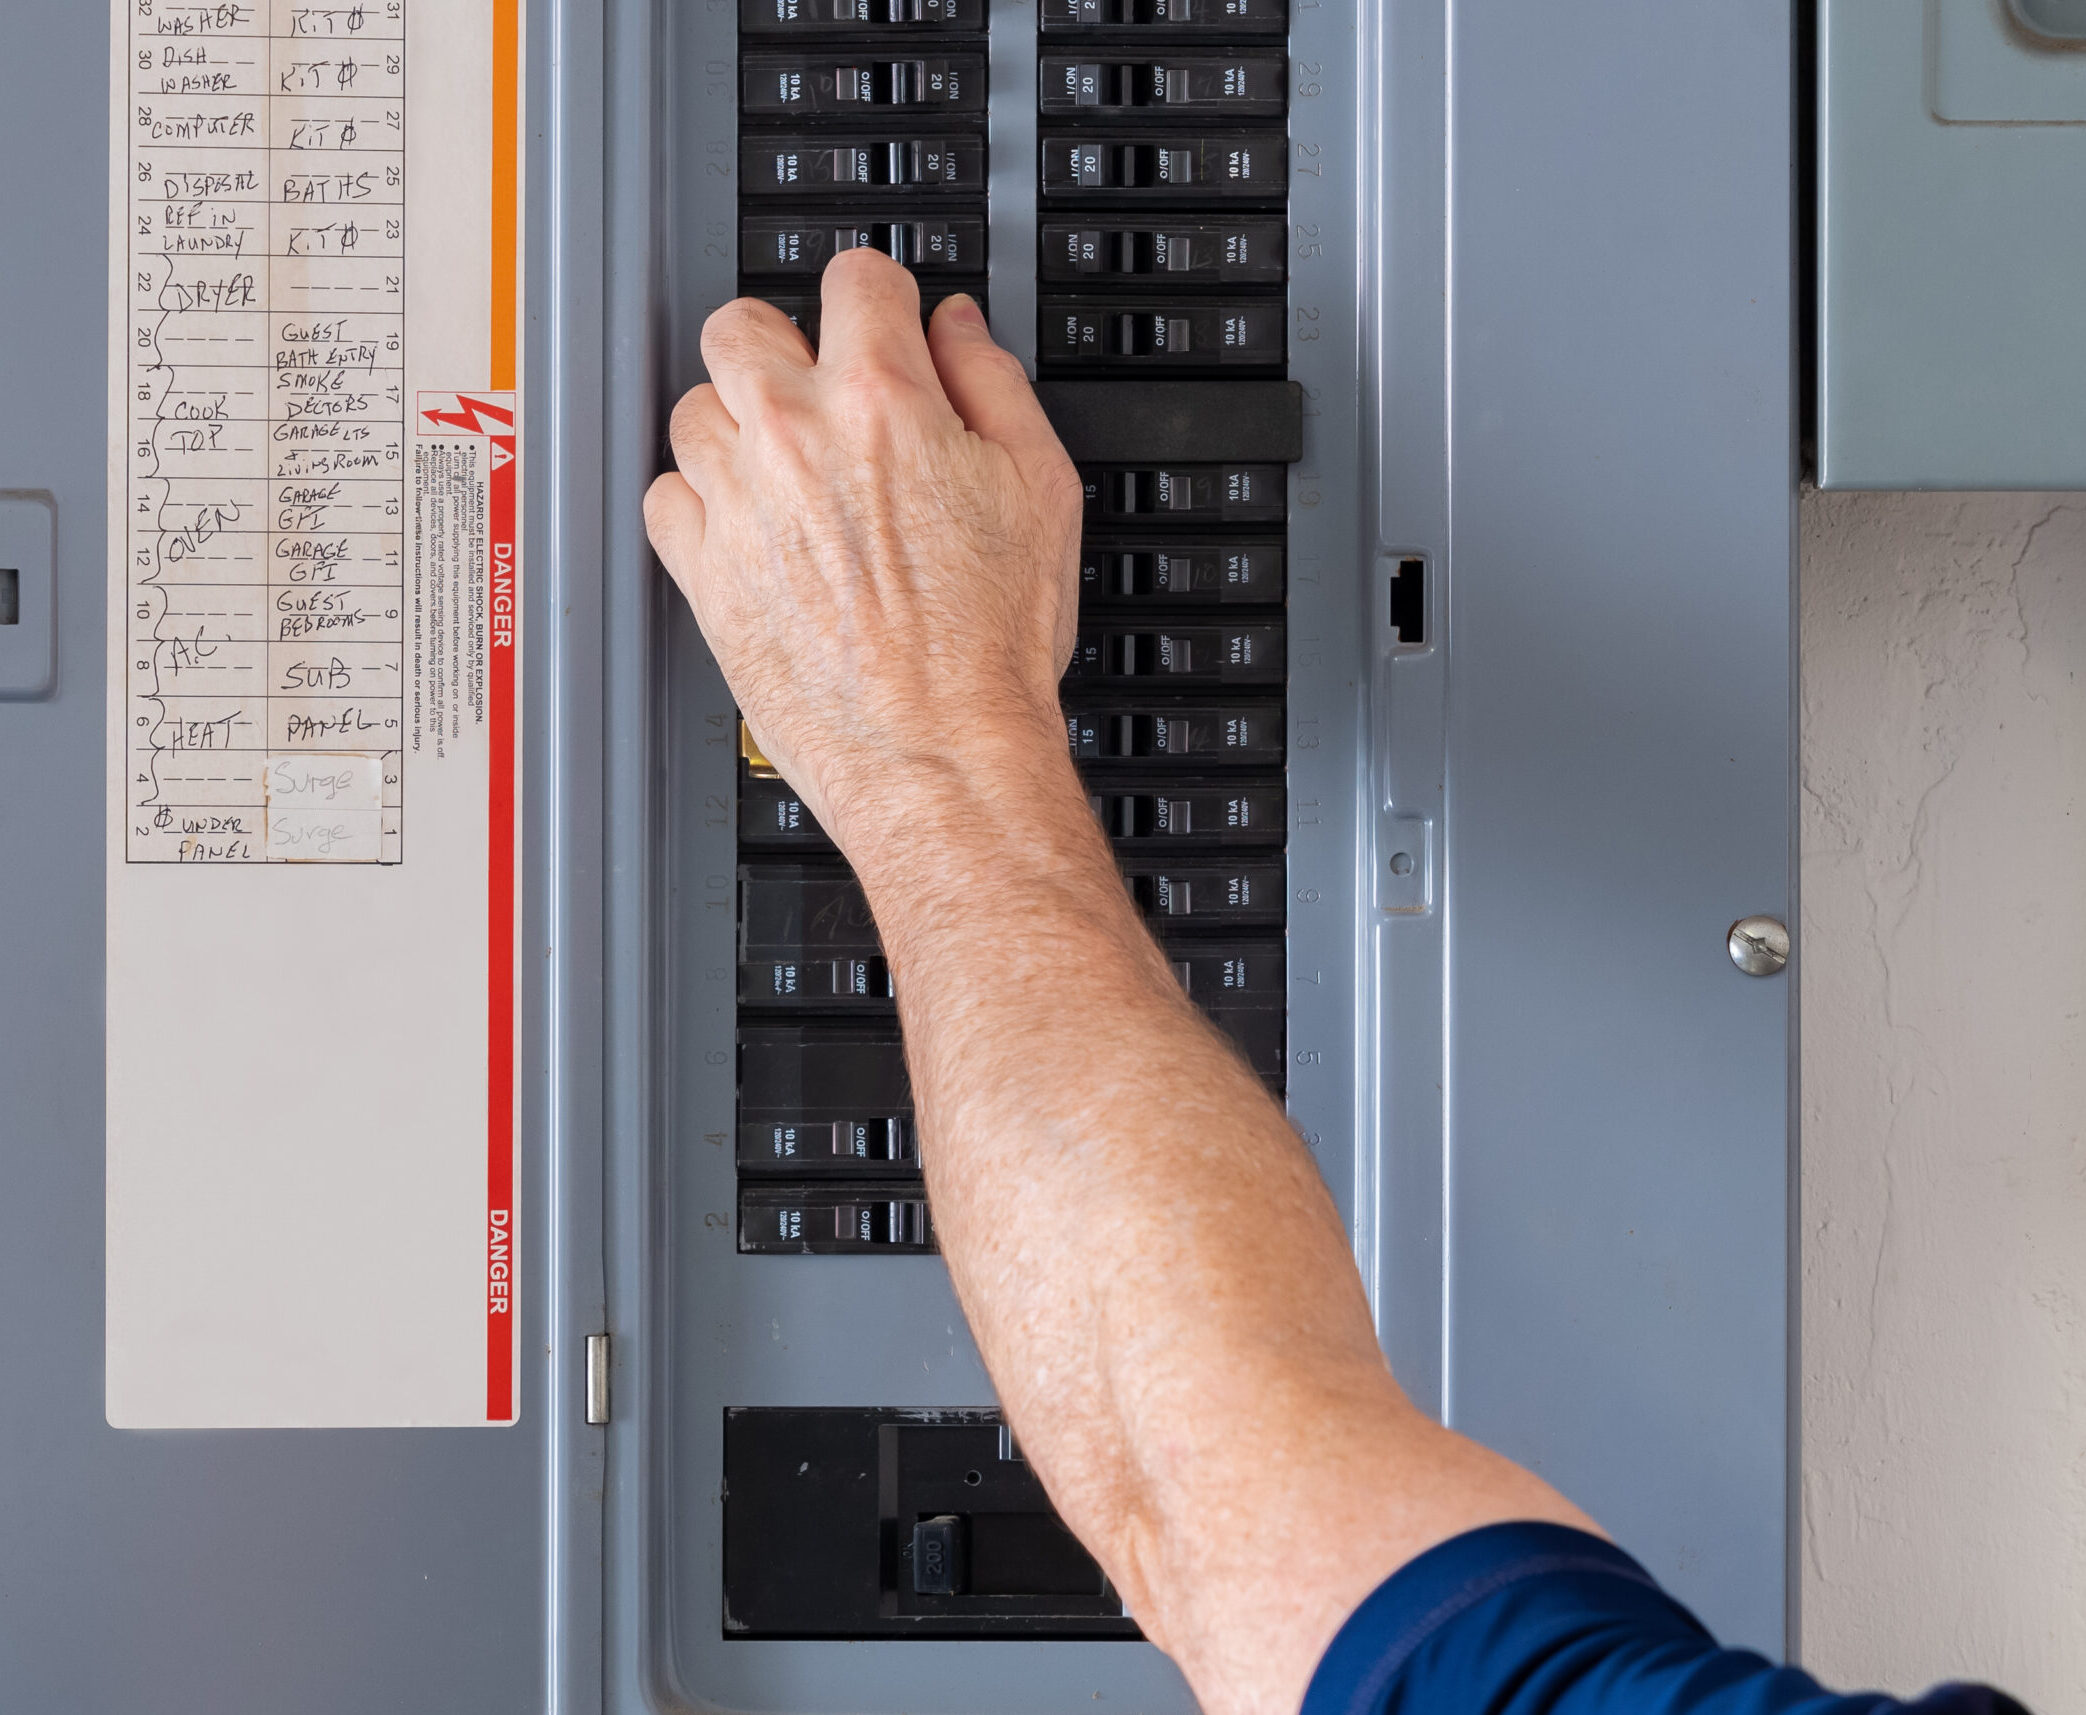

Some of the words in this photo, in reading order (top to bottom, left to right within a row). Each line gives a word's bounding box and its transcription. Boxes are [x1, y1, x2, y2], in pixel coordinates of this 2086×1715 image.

[158, 4, 249, 35] WASHER
[387, 3, 399, 18] 31
[139, 51, 151, 69] 30
[387, 55, 399, 74] 29
[162, 73, 236, 93] WASHER
[791, 74, 800, 84] 10
[932, 74, 942, 89] 20
[1155, 67, 1163, 95] O/OFF
[1225, 69, 1234, 81] kA
[1299, 62, 1322, 97] 29
[791, 87, 800, 100] kA
[861, 72, 870, 101] O/OFF
[1083, 78, 1093, 93] 20
[1225, 80, 1234, 95] 10
[139, 107, 151, 126] 28
[152, 113, 255, 139] COMPUTER
[387, 111, 399, 130] 27
[859, 153, 867, 182] O/OFF
[928, 155, 938, 169] 20
[1085, 157, 1095, 171] 20
[1160, 149, 1168, 178] O/OFF
[1298, 144, 1321, 177] 27
[139, 162, 151, 181] 26
[387, 167, 399, 185] 25
[284, 172, 372, 202] BATHS
[166, 202, 203, 225] REF
[139, 216, 151, 235] 24
[387, 220, 399, 239] 23
[164, 230, 244, 259] LAUNDRY
[932, 236, 941, 250] 20
[1157, 234, 1165, 263] O/OFF
[1297, 224, 1322, 257] 25
[1083, 244, 1093, 259] 20
[138, 273, 151, 291] 22
[387, 276, 399, 292] 21
[178, 273, 255, 313] DRYER
[138, 328, 151, 347] 20
[282, 320, 347, 341] GUEST
[1083, 327, 1093, 341] 20
[1156, 316, 1164, 345] O/OFF
[387, 333, 399, 350] 19
[277, 348, 317, 370] BATH
[326, 347, 376, 375] ENTRY
[277, 370, 345, 389] SMOKE
[138, 383, 150, 400] 18
[387, 386, 399, 403] 17
[175, 396, 229, 419] COOK
[171, 424, 223, 454] TOP
[274, 422, 339, 441] GARAGE
[137, 439, 150, 458] 16
[386, 443, 398, 459] 15
[437, 451, 445, 478] Always
[468, 451, 476, 468] This
[416, 476, 422, 484] to
[1160, 472, 1168, 501] O/OFF
[279, 482, 341, 503] GARAGE
[476, 482, 484, 520] HAZARD
[1086, 485, 1095, 498] 15
[138, 495, 150, 512] 14
[386, 498, 398, 515] 13
[170, 499, 240, 562] OVEN
[436, 506, 444, 538] properly
[476, 523, 483, 534] OF
[276, 539, 349, 560] GARAGE
[468, 538, 476, 548] be
[137, 548, 150, 565] 12
[386, 551, 398, 565] 11
[476, 538, 484, 583] ELECTRIC
[290, 562, 338, 581] GFI
[468, 551, 476, 584] installed
[1085, 568, 1097, 580] 15
[436, 565, 445, 593] voltage
[277, 590, 350, 611] GUEST
[468, 586, 476, 601] and
[494, 543, 512, 647] DANGER
[137, 601, 149, 619] 10
[385, 610, 398, 618] 9
[436, 596, 444, 626] sensing
[415, 642, 422, 650] in
[467, 641, 475, 657] only
[1086, 648, 1096, 660] 15
[137, 661, 149, 670] 8
[385, 663, 398, 671] 7
[467, 660, 475, 669] by
[476, 653, 482, 665] OR
[281, 658, 351, 689] SUB
[414, 680, 421, 689] or
[467, 672, 475, 706] qualified
[475, 669, 483, 724] EXPLOSION.
[414, 692, 422, 723] serious
[137, 717, 149, 726] 6
[288, 708, 372, 741] PANEL
[385, 719, 397, 728] 5
[172, 711, 241, 758] HEAT
[413, 727, 422, 754] injury.
[137, 774, 149, 782] 4
[274, 761, 353, 800] Surge
[385, 775, 397, 784] 3
[136, 827, 149, 835] 2
[182, 818, 242, 832] UNDER
[272, 818, 353, 853] Surge
[180, 840, 250, 862] PANEL
[857, 1128, 865, 1156] O/OFF
[791, 1212, 800, 1222] 10
[861, 1211, 869, 1240] O/OFF
[791, 1225, 800, 1238] kA
[490, 1210, 508, 1314] DANGER
[927, 1541, 944, 1575] 200
